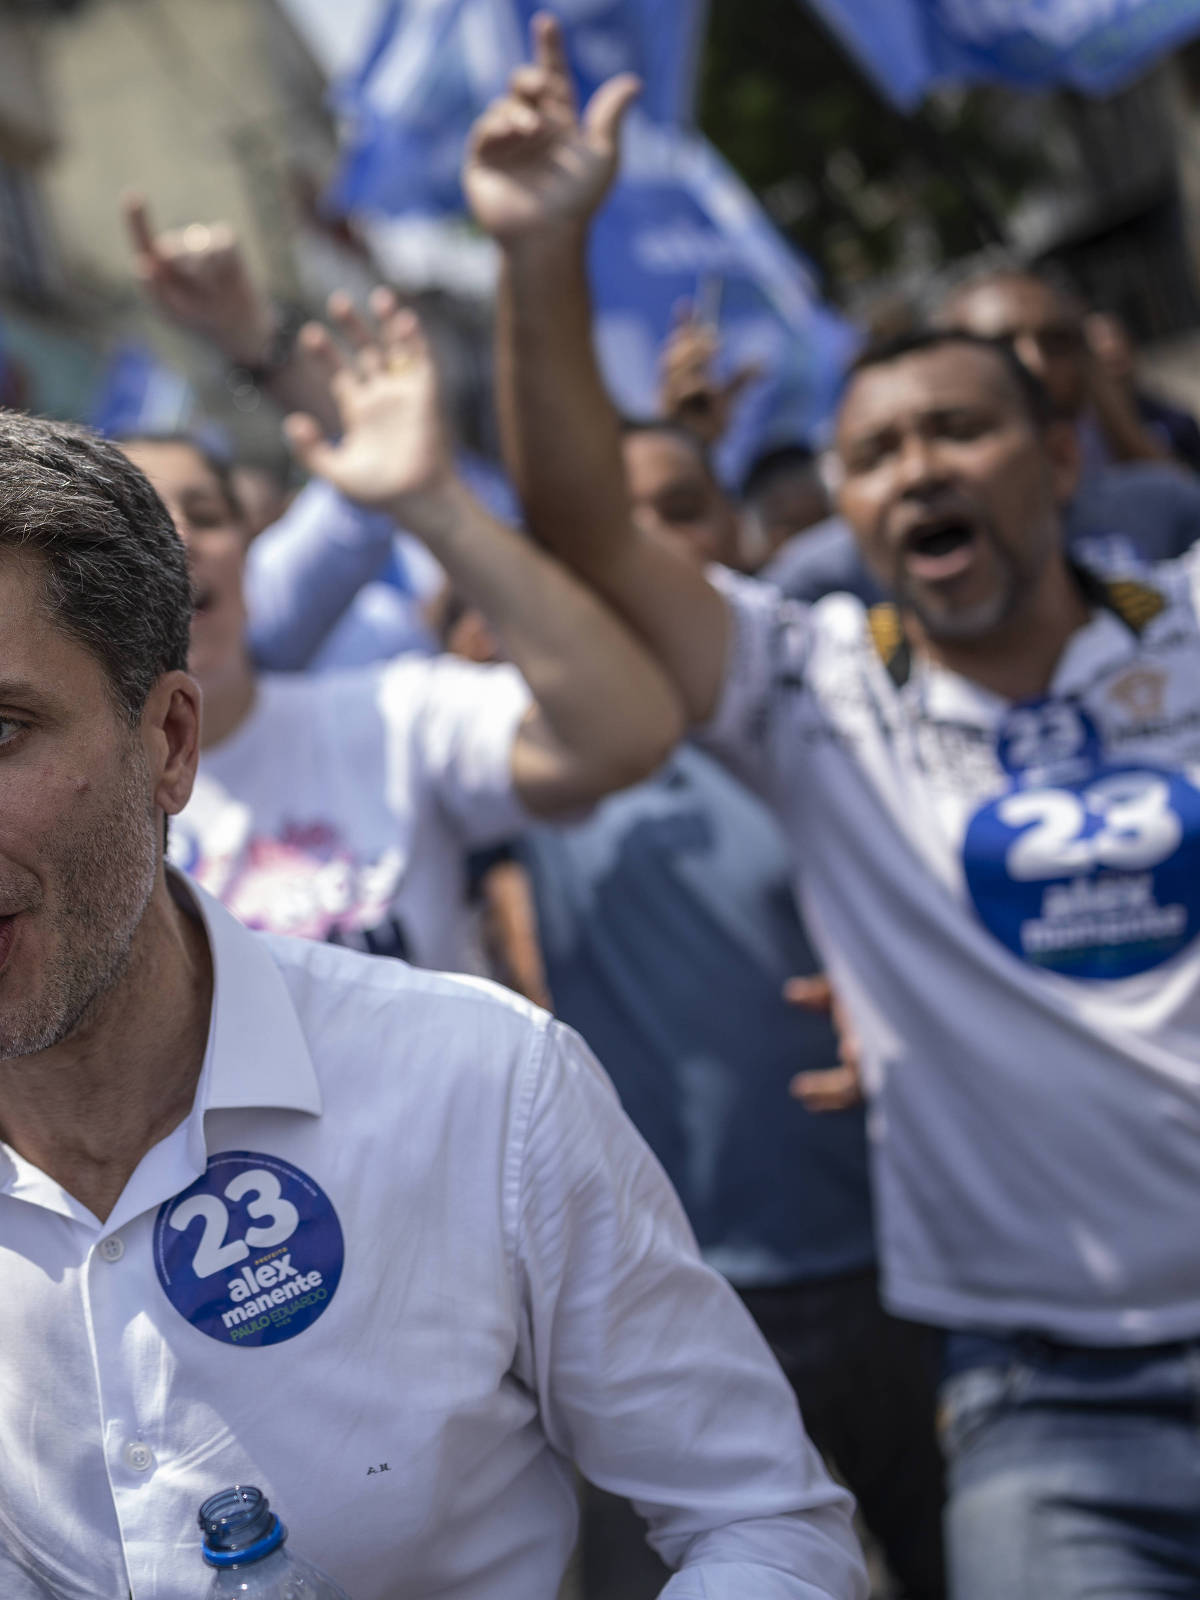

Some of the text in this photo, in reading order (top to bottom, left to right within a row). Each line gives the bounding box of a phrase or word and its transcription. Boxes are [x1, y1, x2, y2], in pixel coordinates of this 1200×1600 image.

[997, 770, 1184, 882] 23
[169, 1169, 299, 1279] 23
[221, 1270, 324, 1328] manente
[227, 1254, 298, 1302] alex
[230, 1288, 328, 1342] PAULO EDUARDO
